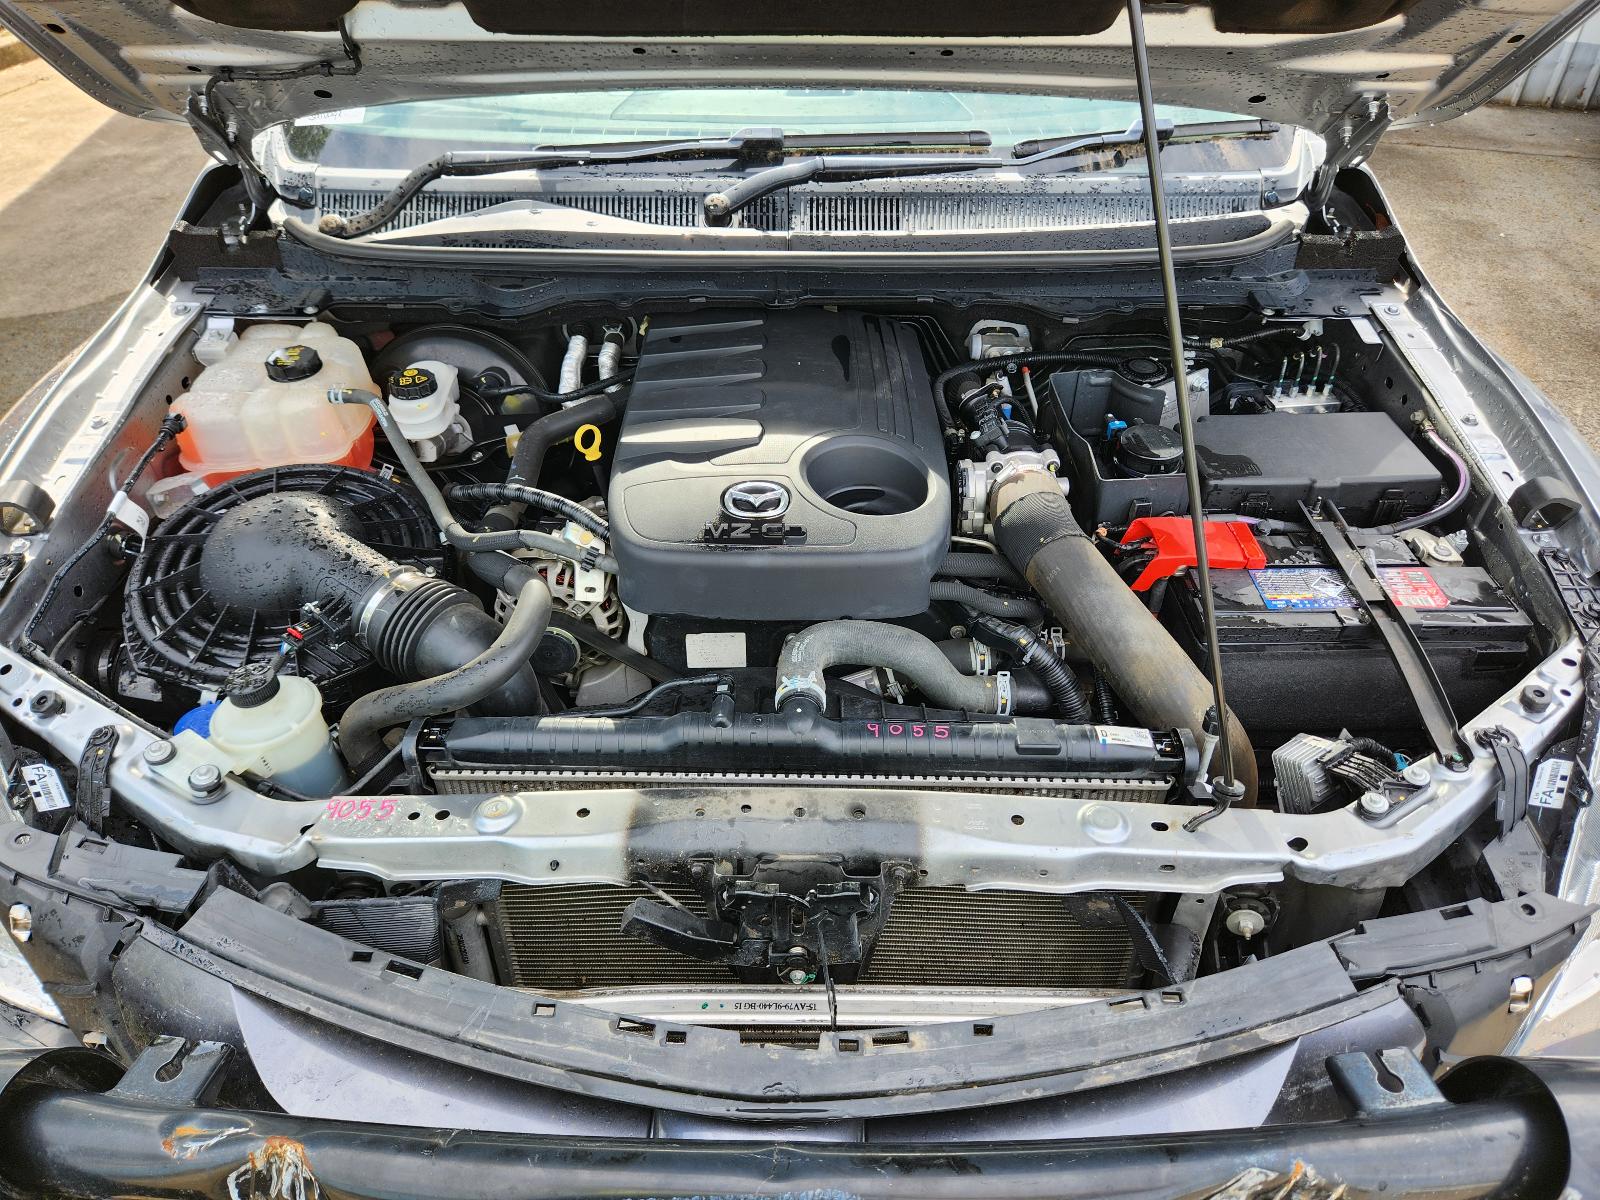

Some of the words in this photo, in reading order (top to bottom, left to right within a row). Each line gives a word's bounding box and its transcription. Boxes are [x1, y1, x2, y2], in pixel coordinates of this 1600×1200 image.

[866, 722, 951, 739] 9055
[32, 766, 48, 781] FA
[1539, 789, 1555, 805] FA
[327, 799, 398, 820] 9055
